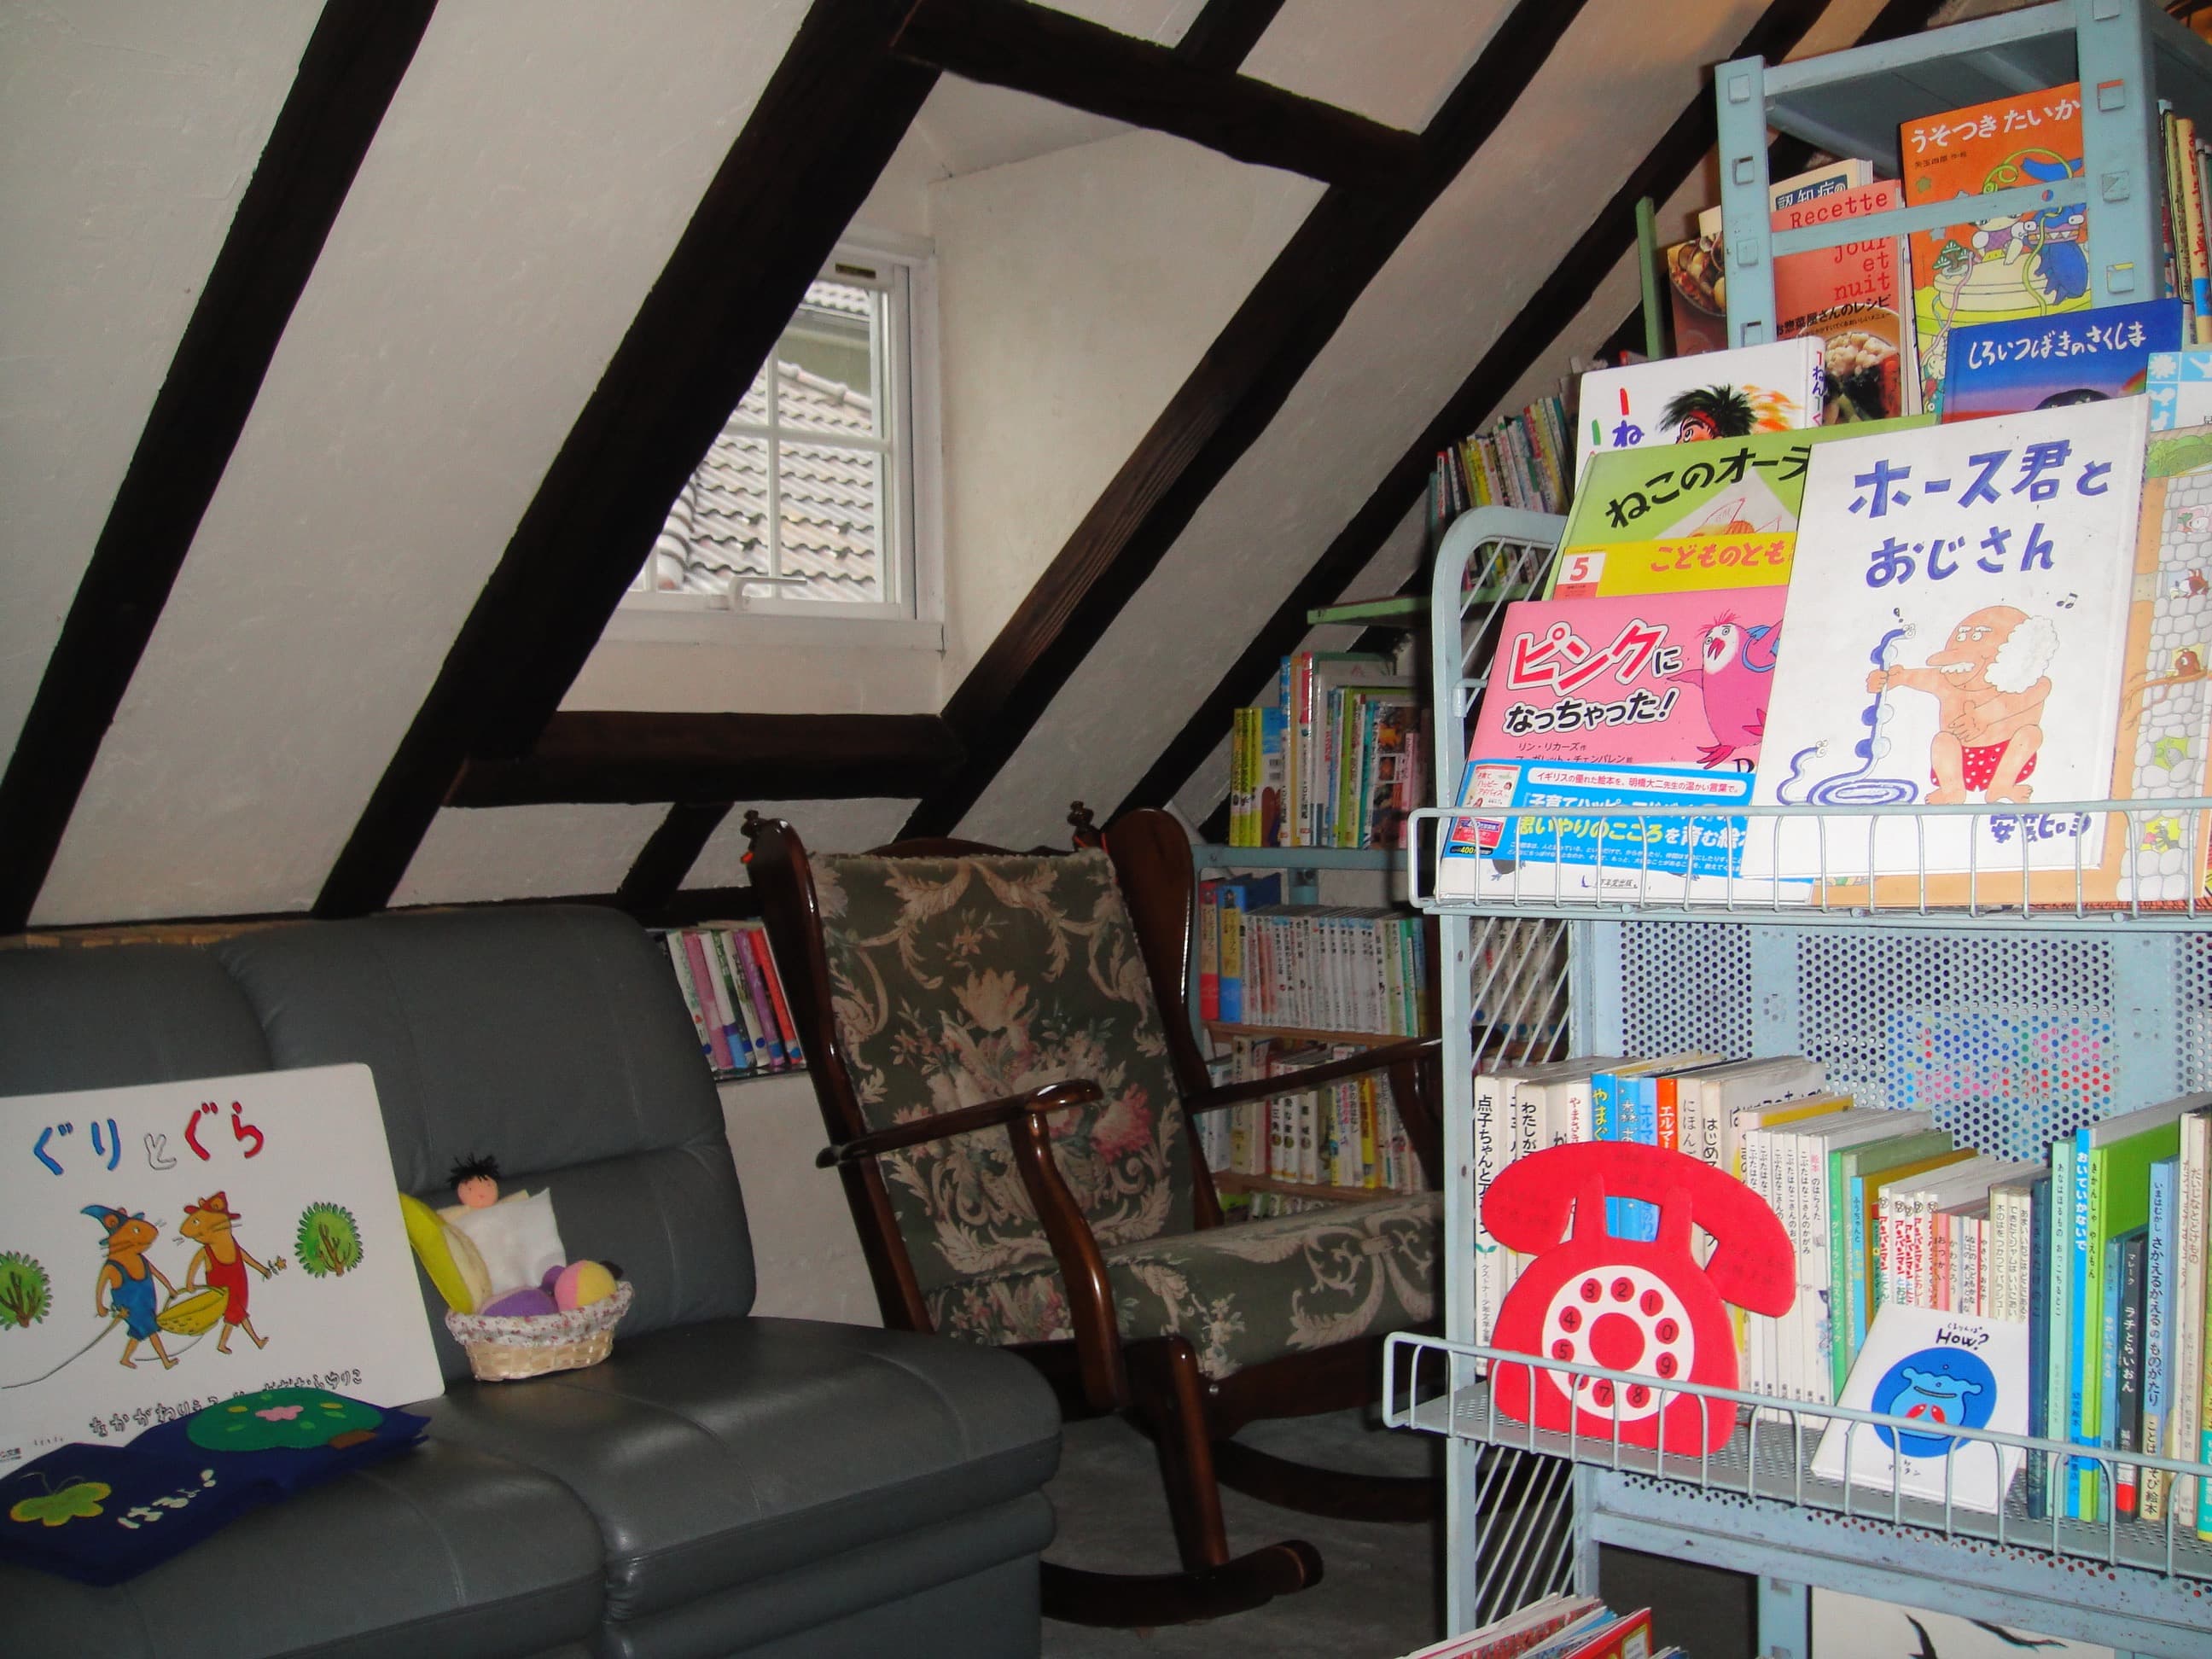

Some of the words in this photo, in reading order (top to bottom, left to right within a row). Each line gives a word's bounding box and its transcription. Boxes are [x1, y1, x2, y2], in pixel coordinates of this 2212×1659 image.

[1911, 115, 1998, 154] うそつき
[1790, 191, 1889, 229] Recette
[1862, 251, 1889, 271] et
[1834, 272, 1890, 301] nuit
[1848, 439, 2112, 519] ホース君と
[1569, 556, 1590, 581] 5
[1866, 522, 2055, 588] おじさん
[33, 1101, 265, 1176] ぐりとぐら
[1522, 1102, 1537, 1159] わたしが
[1683, 1099, 1697, 1154] にほん
[1585, 1284, 1595, 1298] 3
[1618, 1283, 1627, 1297] 2
[1563, 1311, 1575, 1328] 4
[1662, 1324, 1673, 1341] 0
[1936, 1328, 1989, 1350] How?
[1559, 1342, 1569, 1359] 5
[1661, 1357, 1671, 1375] 9
[1598, 1386, 1610, 1403] 7
[1633, 1386, 1644, 1404] 8
